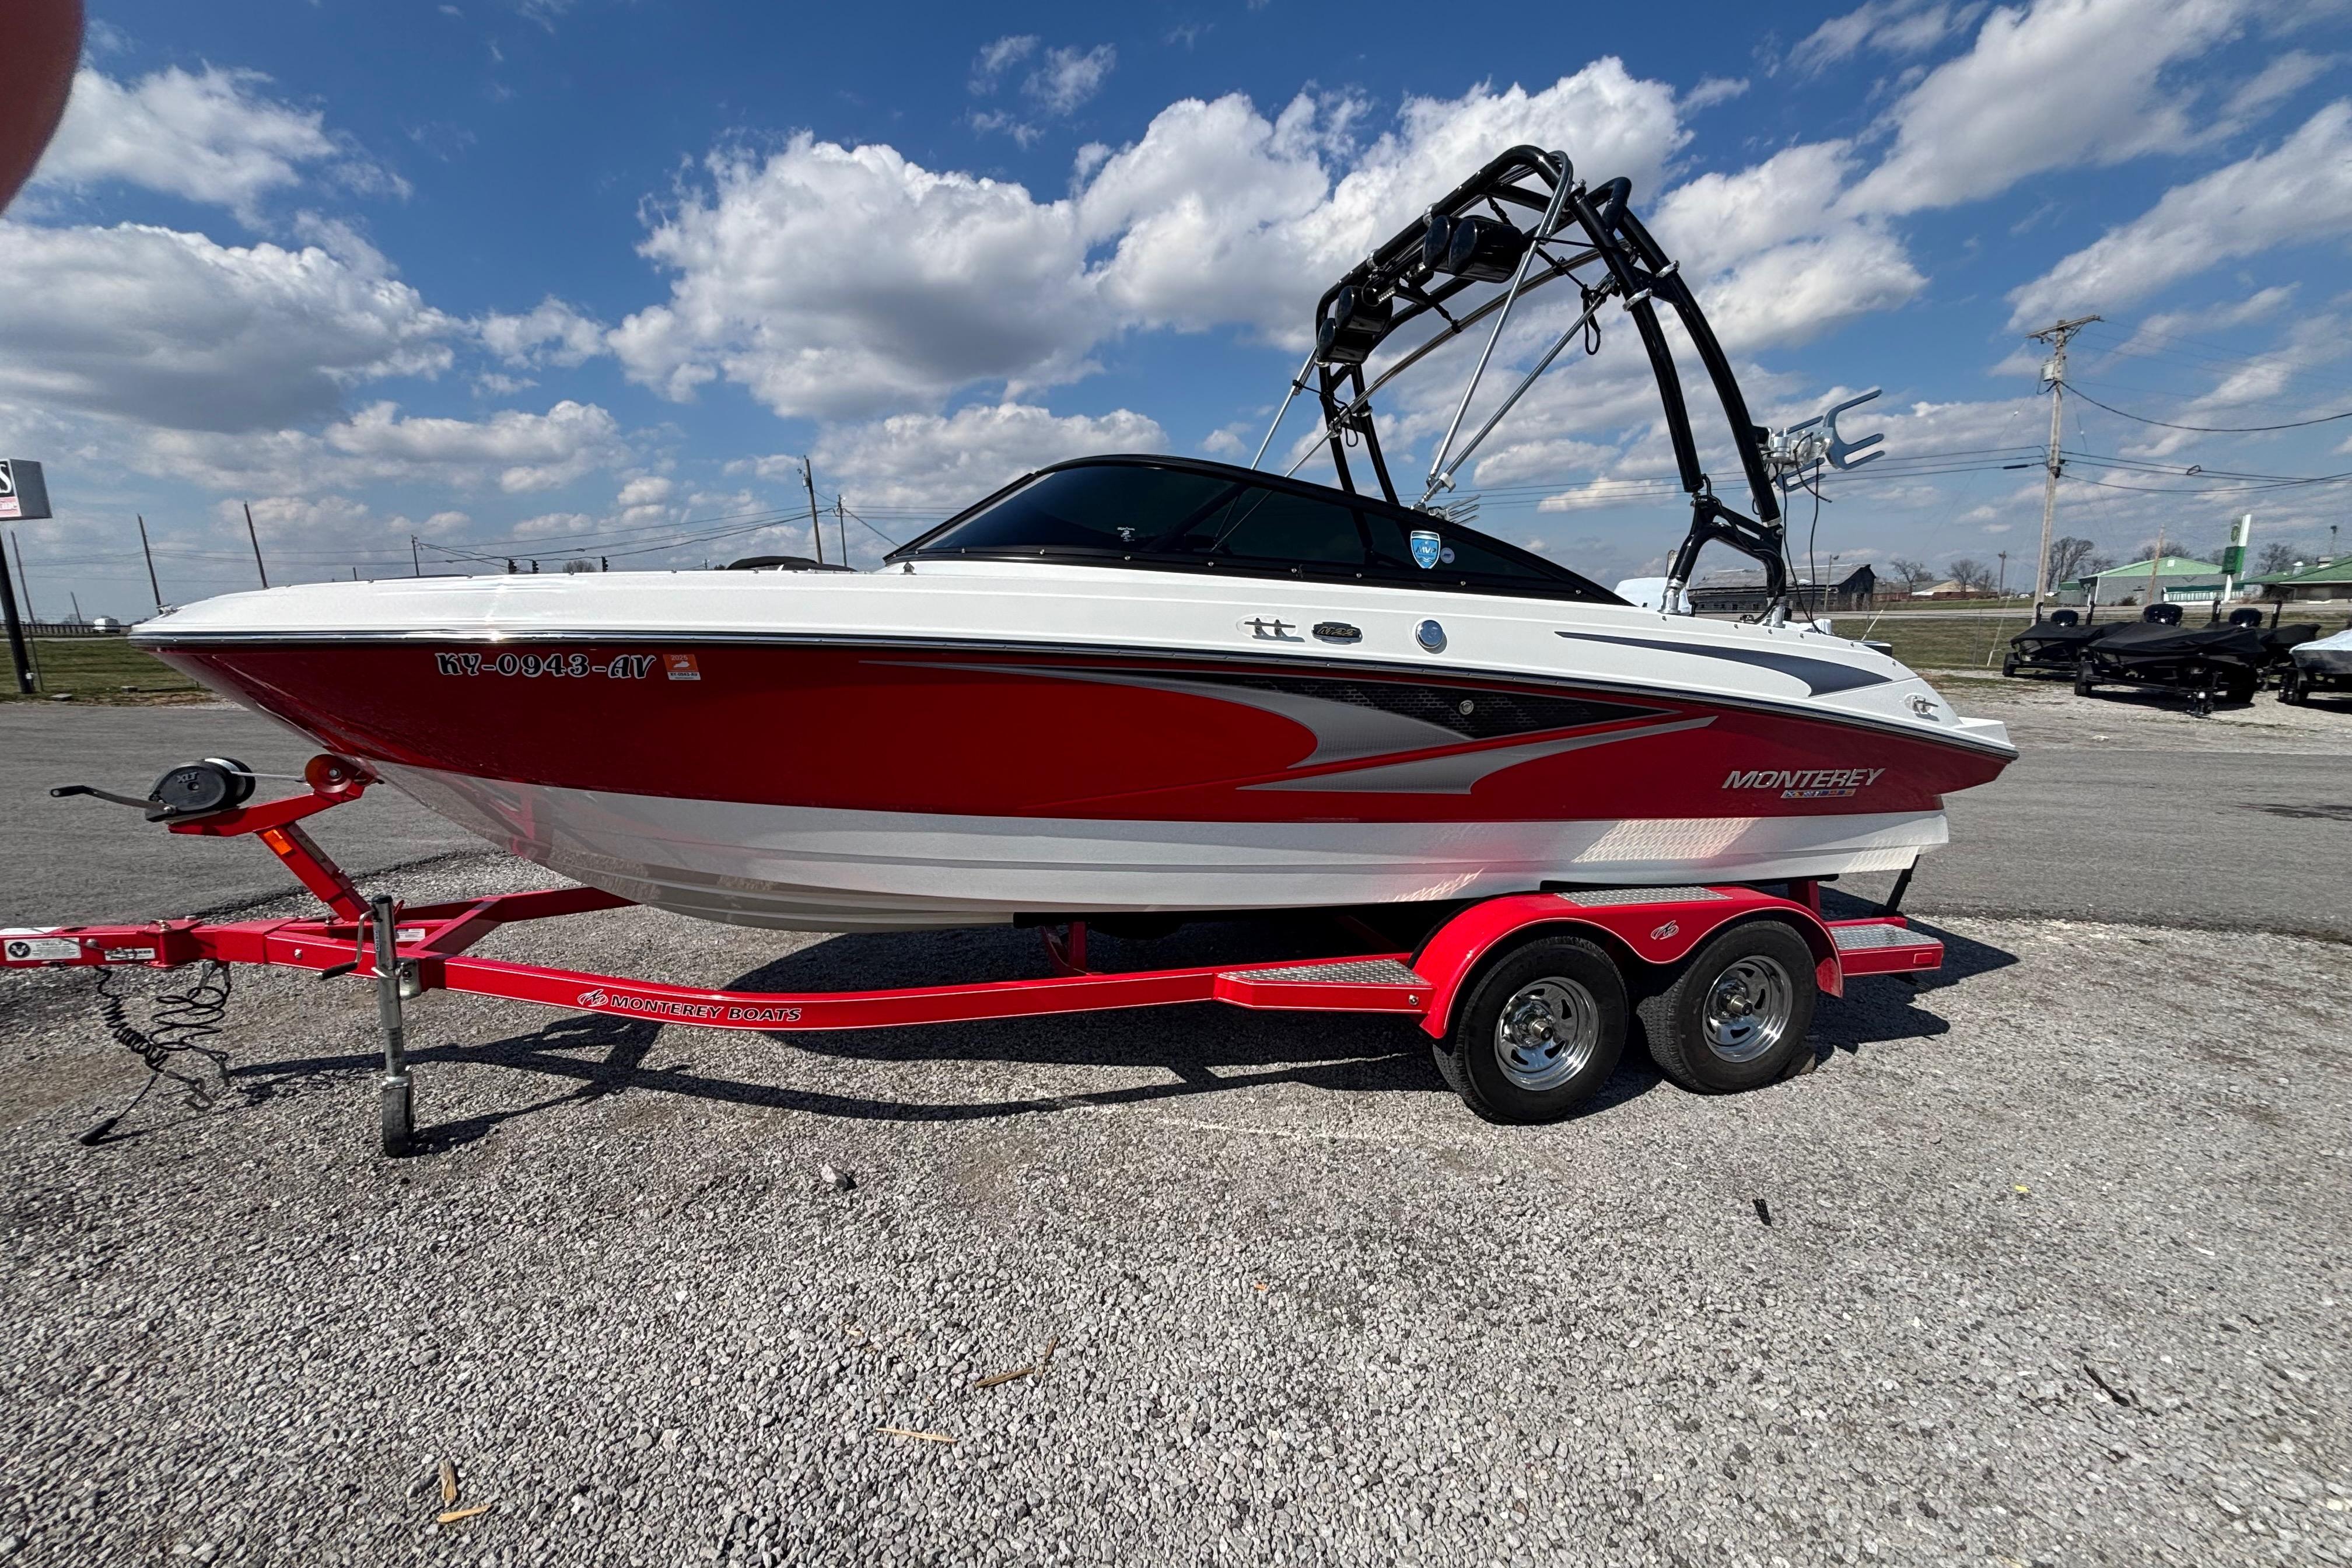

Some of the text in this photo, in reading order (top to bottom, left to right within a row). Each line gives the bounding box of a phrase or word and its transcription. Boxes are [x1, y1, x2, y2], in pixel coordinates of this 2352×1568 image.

[435, 653, 657, 679] KY-0943-AV
[1721, 768, 1886, 789] MONTEREY
[610, 995, 802, 1021] MONTEREY BOATS
